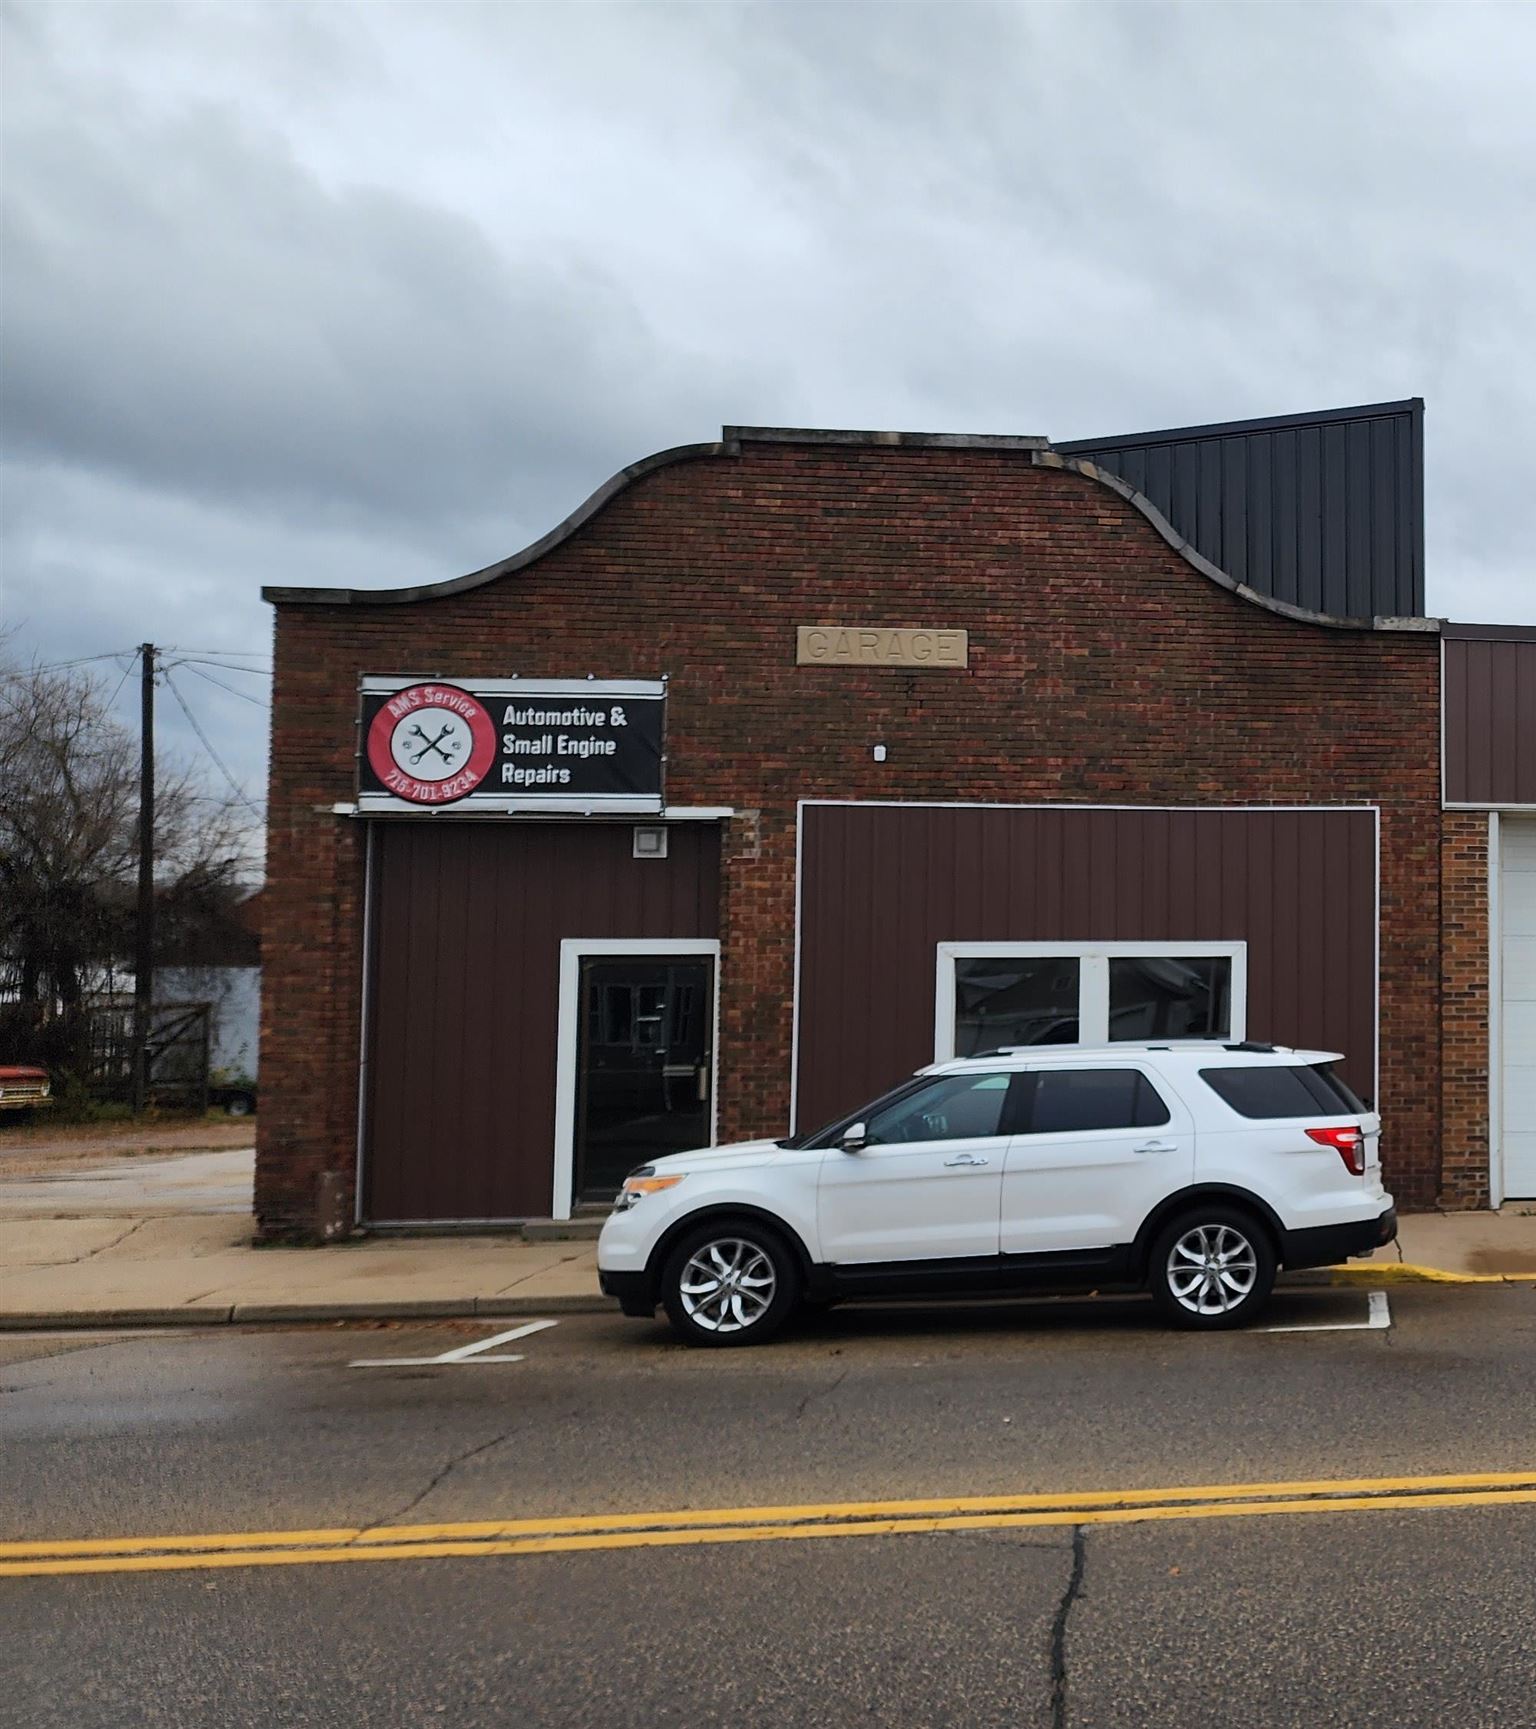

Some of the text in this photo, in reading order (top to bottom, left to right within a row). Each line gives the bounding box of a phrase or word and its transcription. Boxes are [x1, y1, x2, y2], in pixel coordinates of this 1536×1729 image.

[807, 631, 958, 661] GARAGE
[388, 688, 477, 718] AMS Service
[503, 705, 627, 727] Automotive &
[503, 735, 616, 759] Small Engine
[385, 769, 478, 800] 715-701-9234
[502, 763, 571, 787] Repairs
